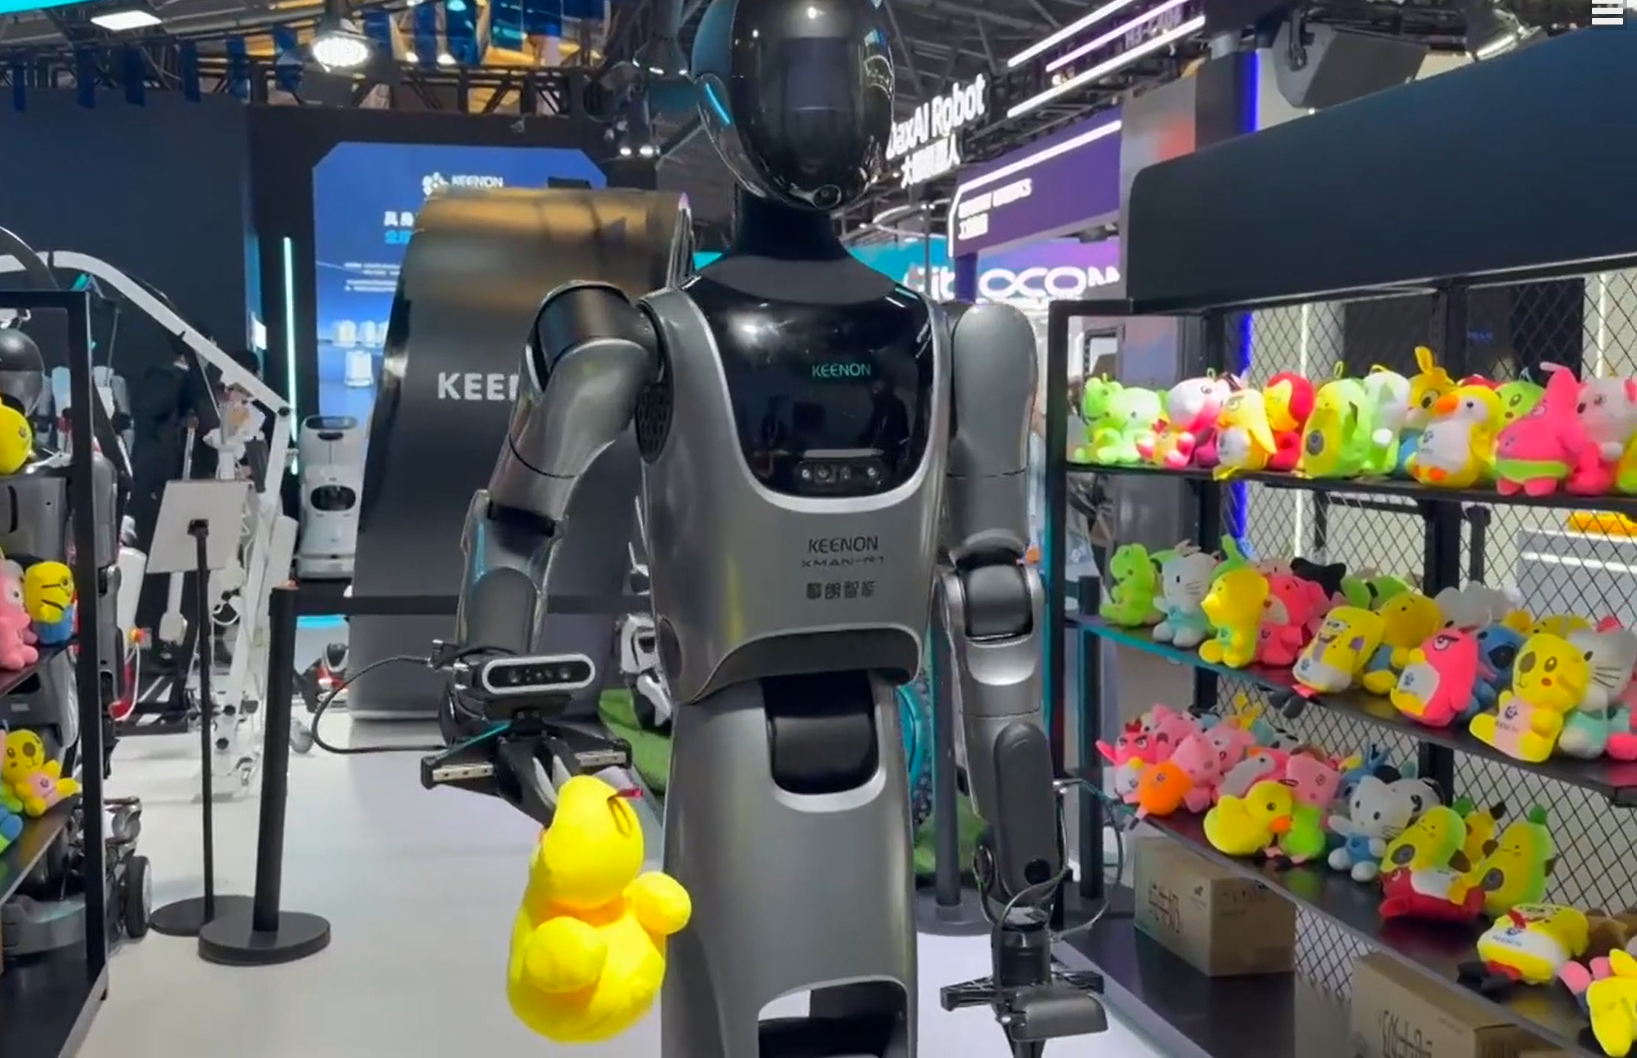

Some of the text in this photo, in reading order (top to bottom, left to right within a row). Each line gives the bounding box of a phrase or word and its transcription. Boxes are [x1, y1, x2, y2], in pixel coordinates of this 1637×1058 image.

[931, 73, 986, 137] Robot
[811, 362, 871, 378] KEENON
[808, 536, 879, 554] KEENON
